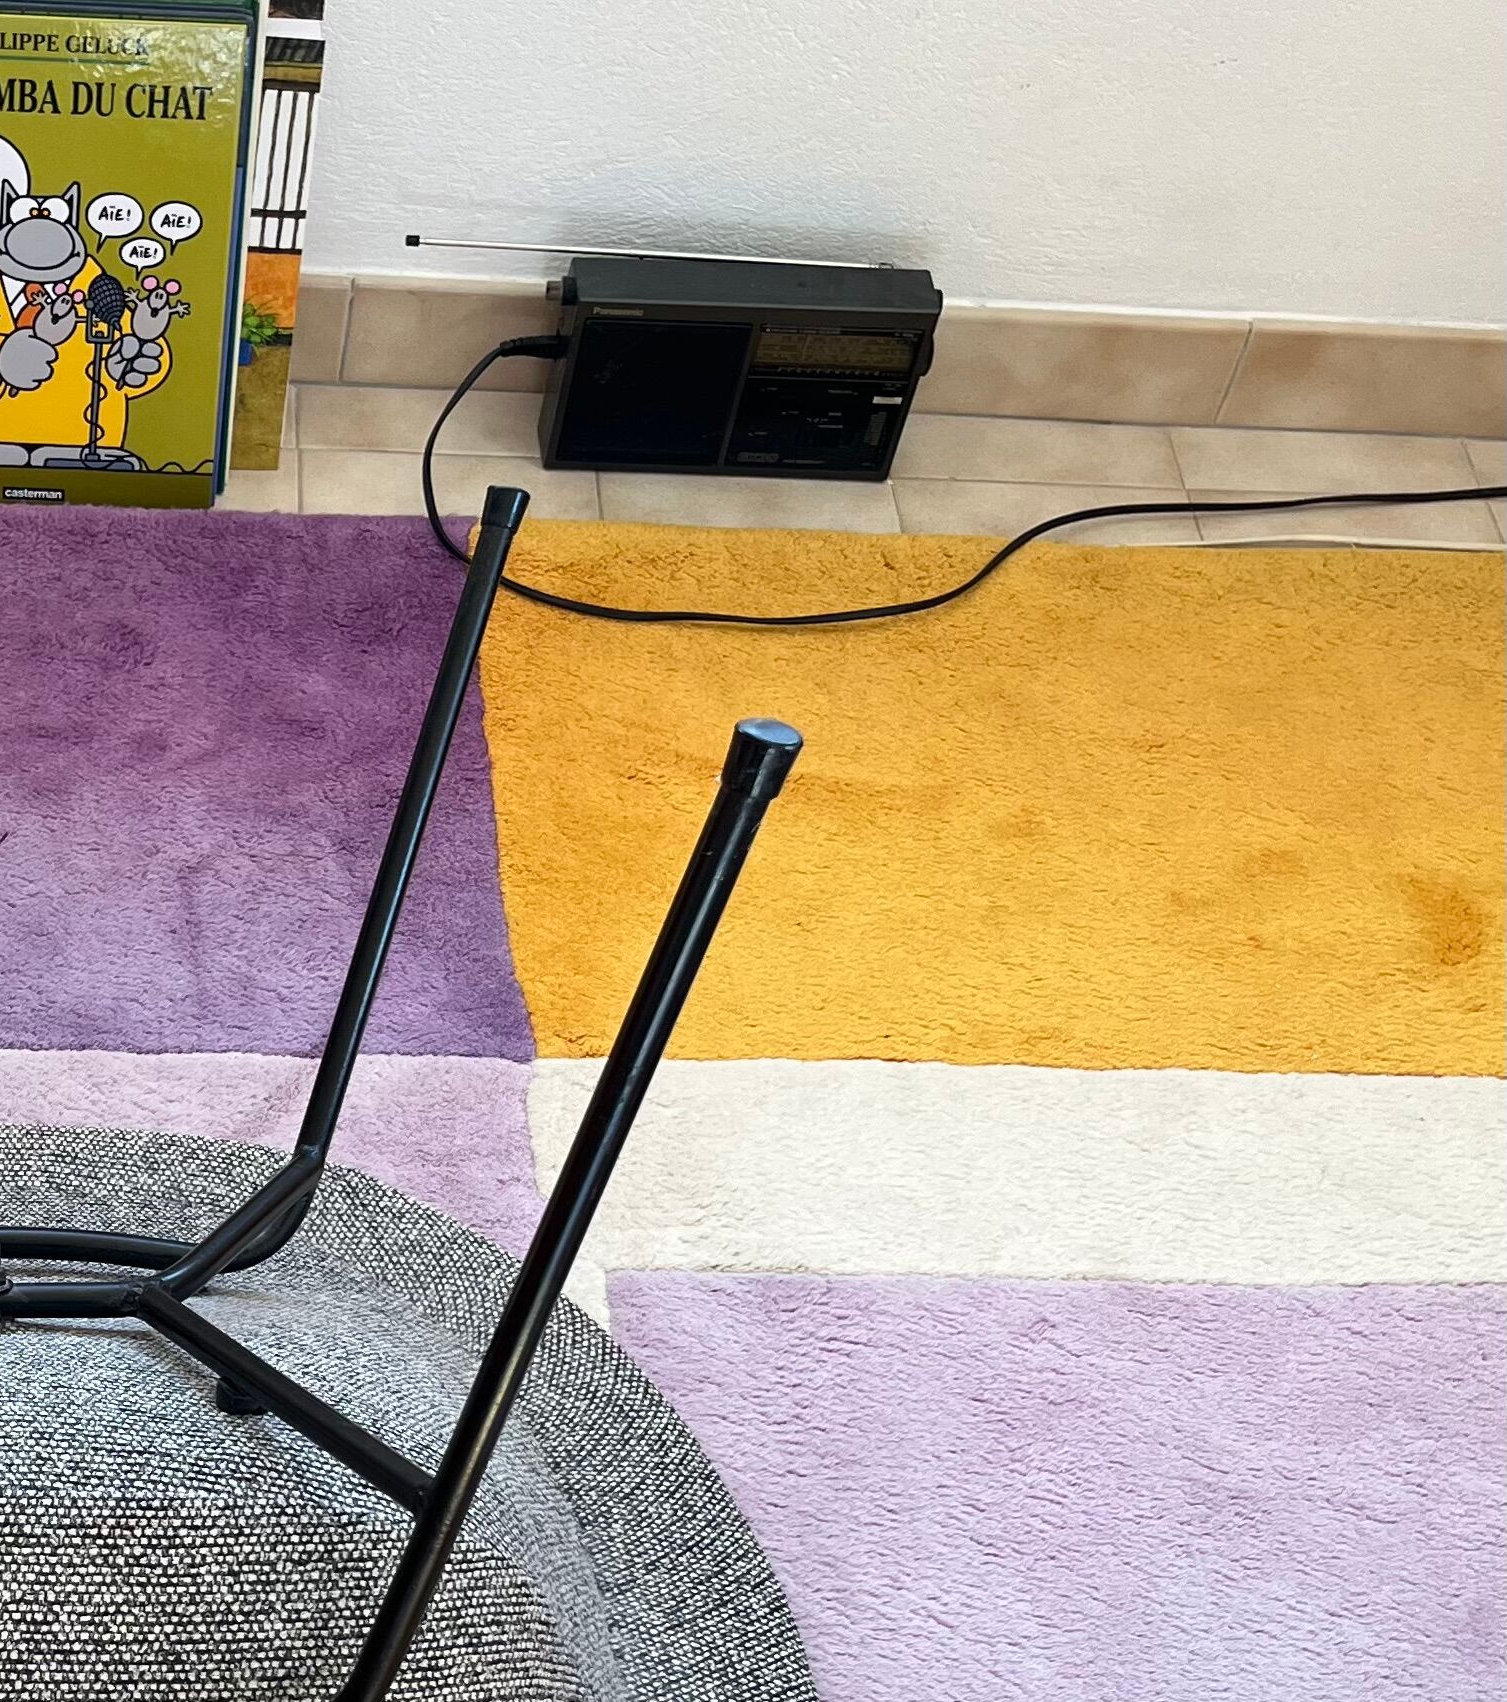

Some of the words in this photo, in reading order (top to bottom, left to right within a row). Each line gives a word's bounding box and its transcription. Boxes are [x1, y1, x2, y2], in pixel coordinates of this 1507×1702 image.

[65, 34, 150, 57] GELUCK
[70, 79, 117, 117] DU
[124, 82, 213, 122] CHAT
[4, 487, 63, 500] casterman
